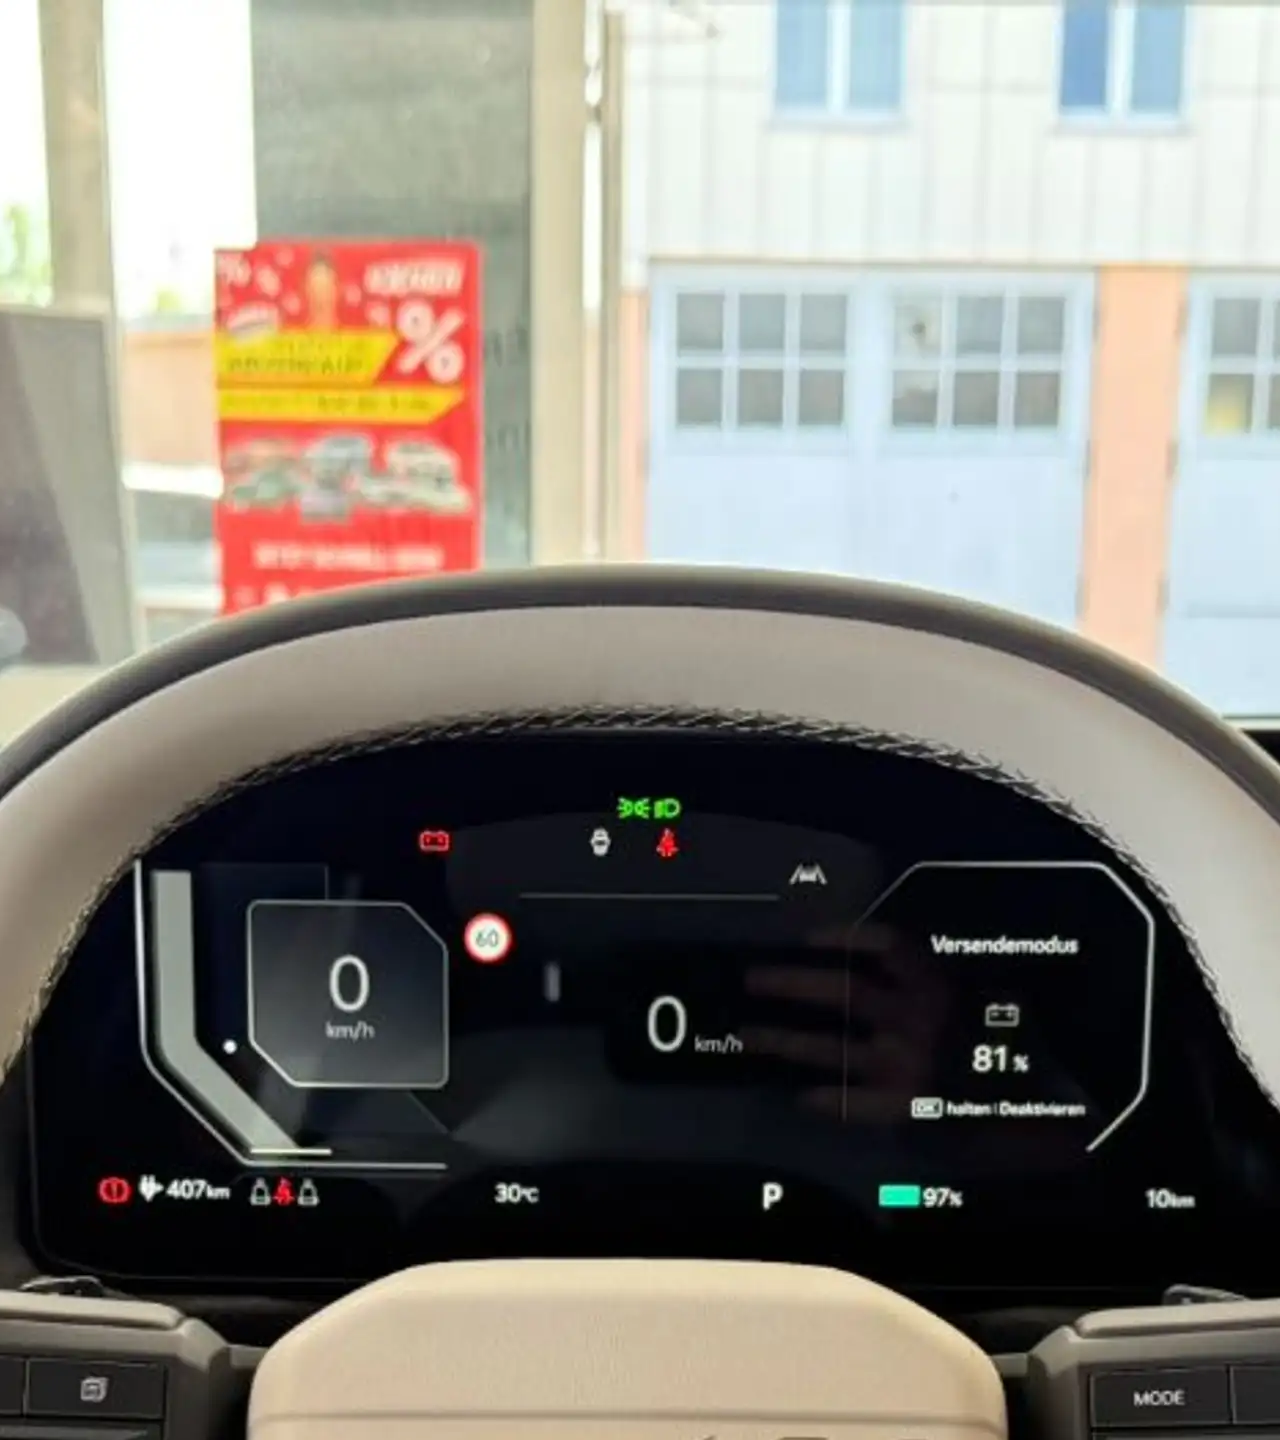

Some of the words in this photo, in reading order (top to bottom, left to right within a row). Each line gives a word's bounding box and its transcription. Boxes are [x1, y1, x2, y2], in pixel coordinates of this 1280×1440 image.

[475, 926, 501, 950] 60
[930, 935, 1079, 954] Versendemodus
[329, 954, 370, 1013] 0
[325, 1020, 375, 1041] km/h
[647, 995, 687, 1052] 0
[694, 1033, 744, 1054] km/h
[946, 1101, 993, 1116] halten
[998, 1100, 1086, 1117] Deaktivieren
[762, 1182, 783, 1210] P
[1133, 1389, 1184, 1406] MODE
